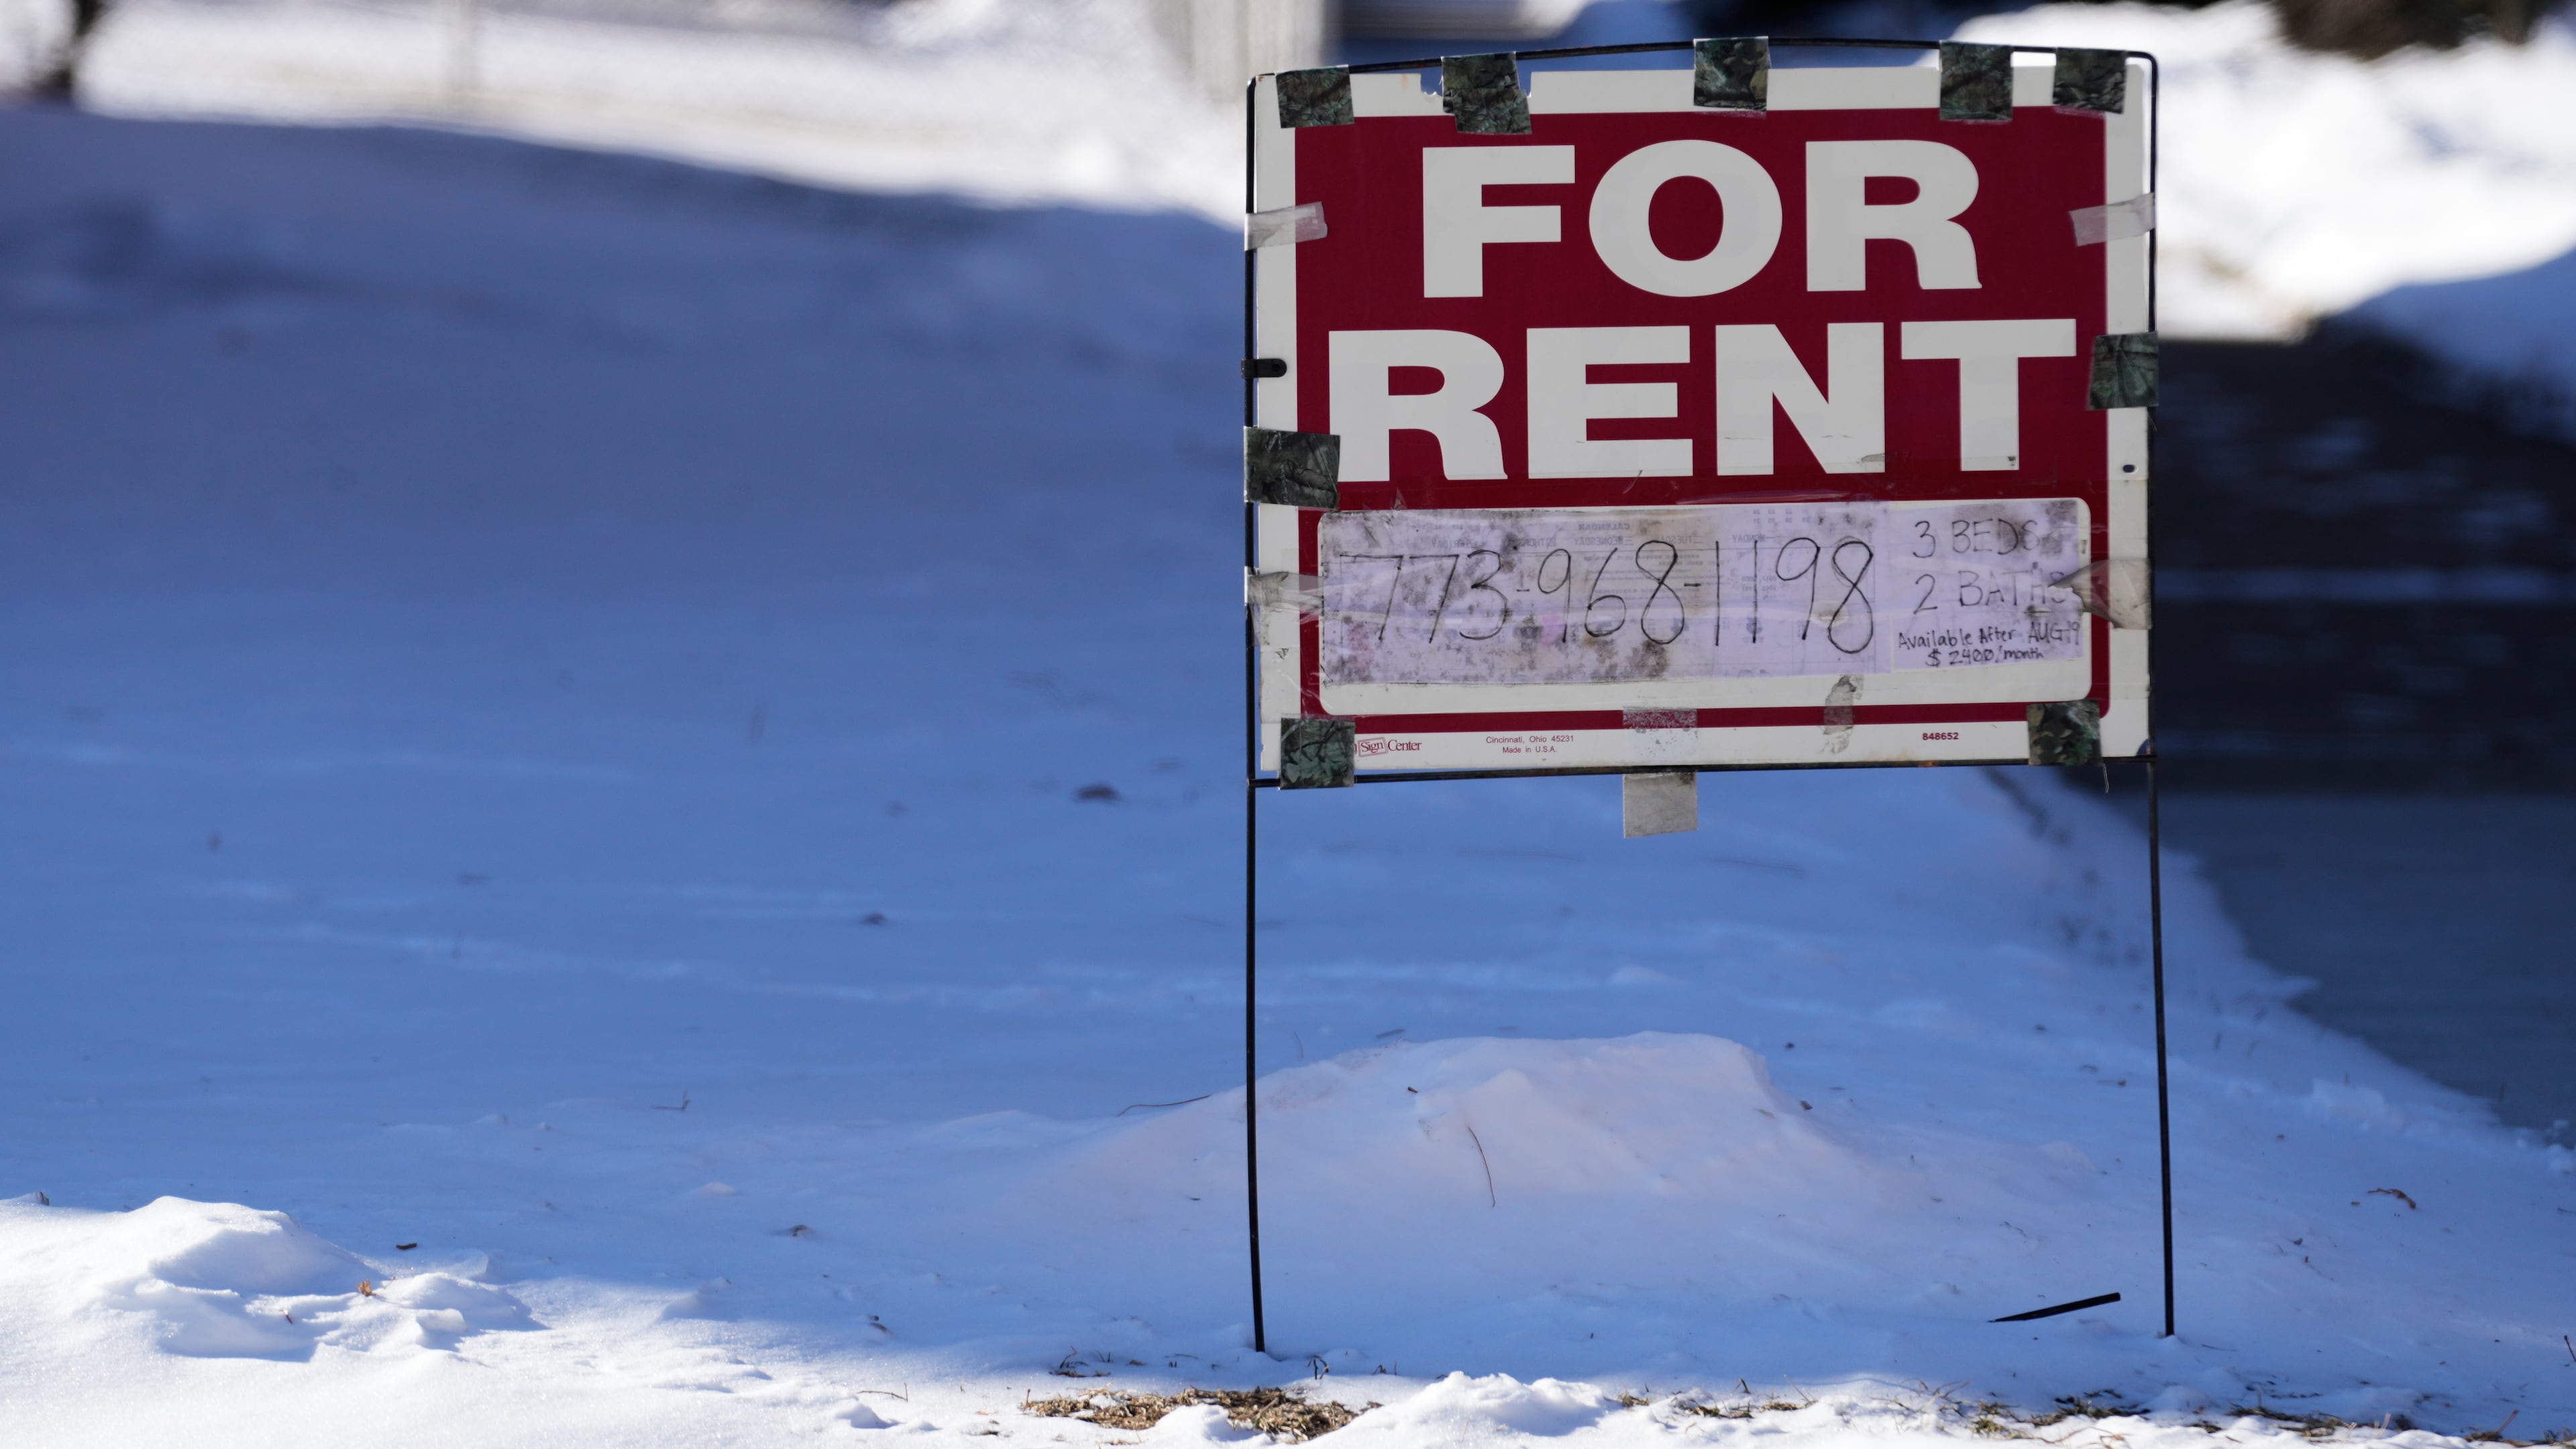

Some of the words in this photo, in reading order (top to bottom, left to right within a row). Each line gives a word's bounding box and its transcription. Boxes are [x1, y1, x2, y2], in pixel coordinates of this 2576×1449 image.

[1423, 139, 1982, 298] FOR
[1329, 318, 2076, 482] RENT
[1913, 520, 1937, 558] 3
[1951, 519, 2041, 555] BEDS
[1913, 574, 1938, 614] 2
[1898, 629, 1973, 650] Available
[1980, 626, 2018, 644] After
[1360, 741, 1384, 754] Sign
[1387, 739, 1422, 752] Center
[1486, 735, 1525, 744] Cincinnati,
[1551, 735, 1574, 743] 45231
[1922, 732, 1959, 741] 848652
